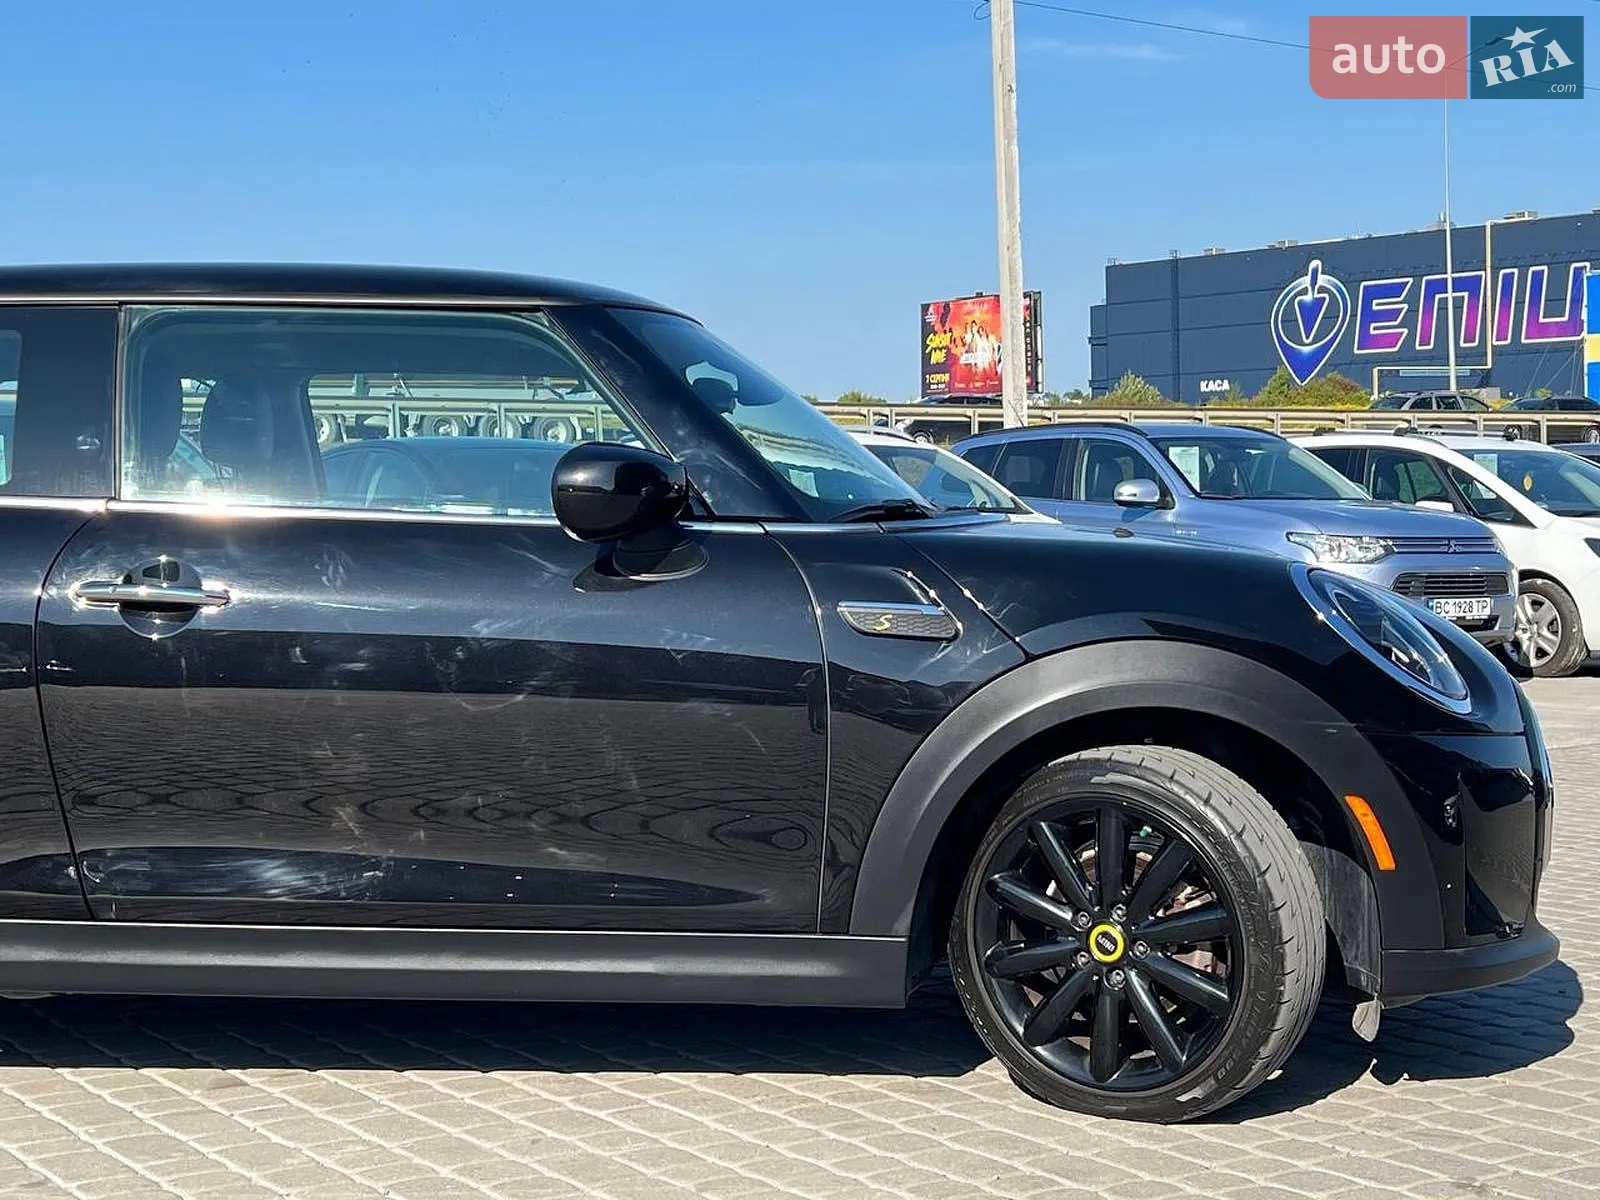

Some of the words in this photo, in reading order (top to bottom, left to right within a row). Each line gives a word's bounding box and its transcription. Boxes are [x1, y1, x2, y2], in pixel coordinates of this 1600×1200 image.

[1435, 601, 1450, 614] BC
[1452, 600, 1474, 614] 1928
[1475, 599, 1489, 613] TP
[874, 613, 893, 631] S
